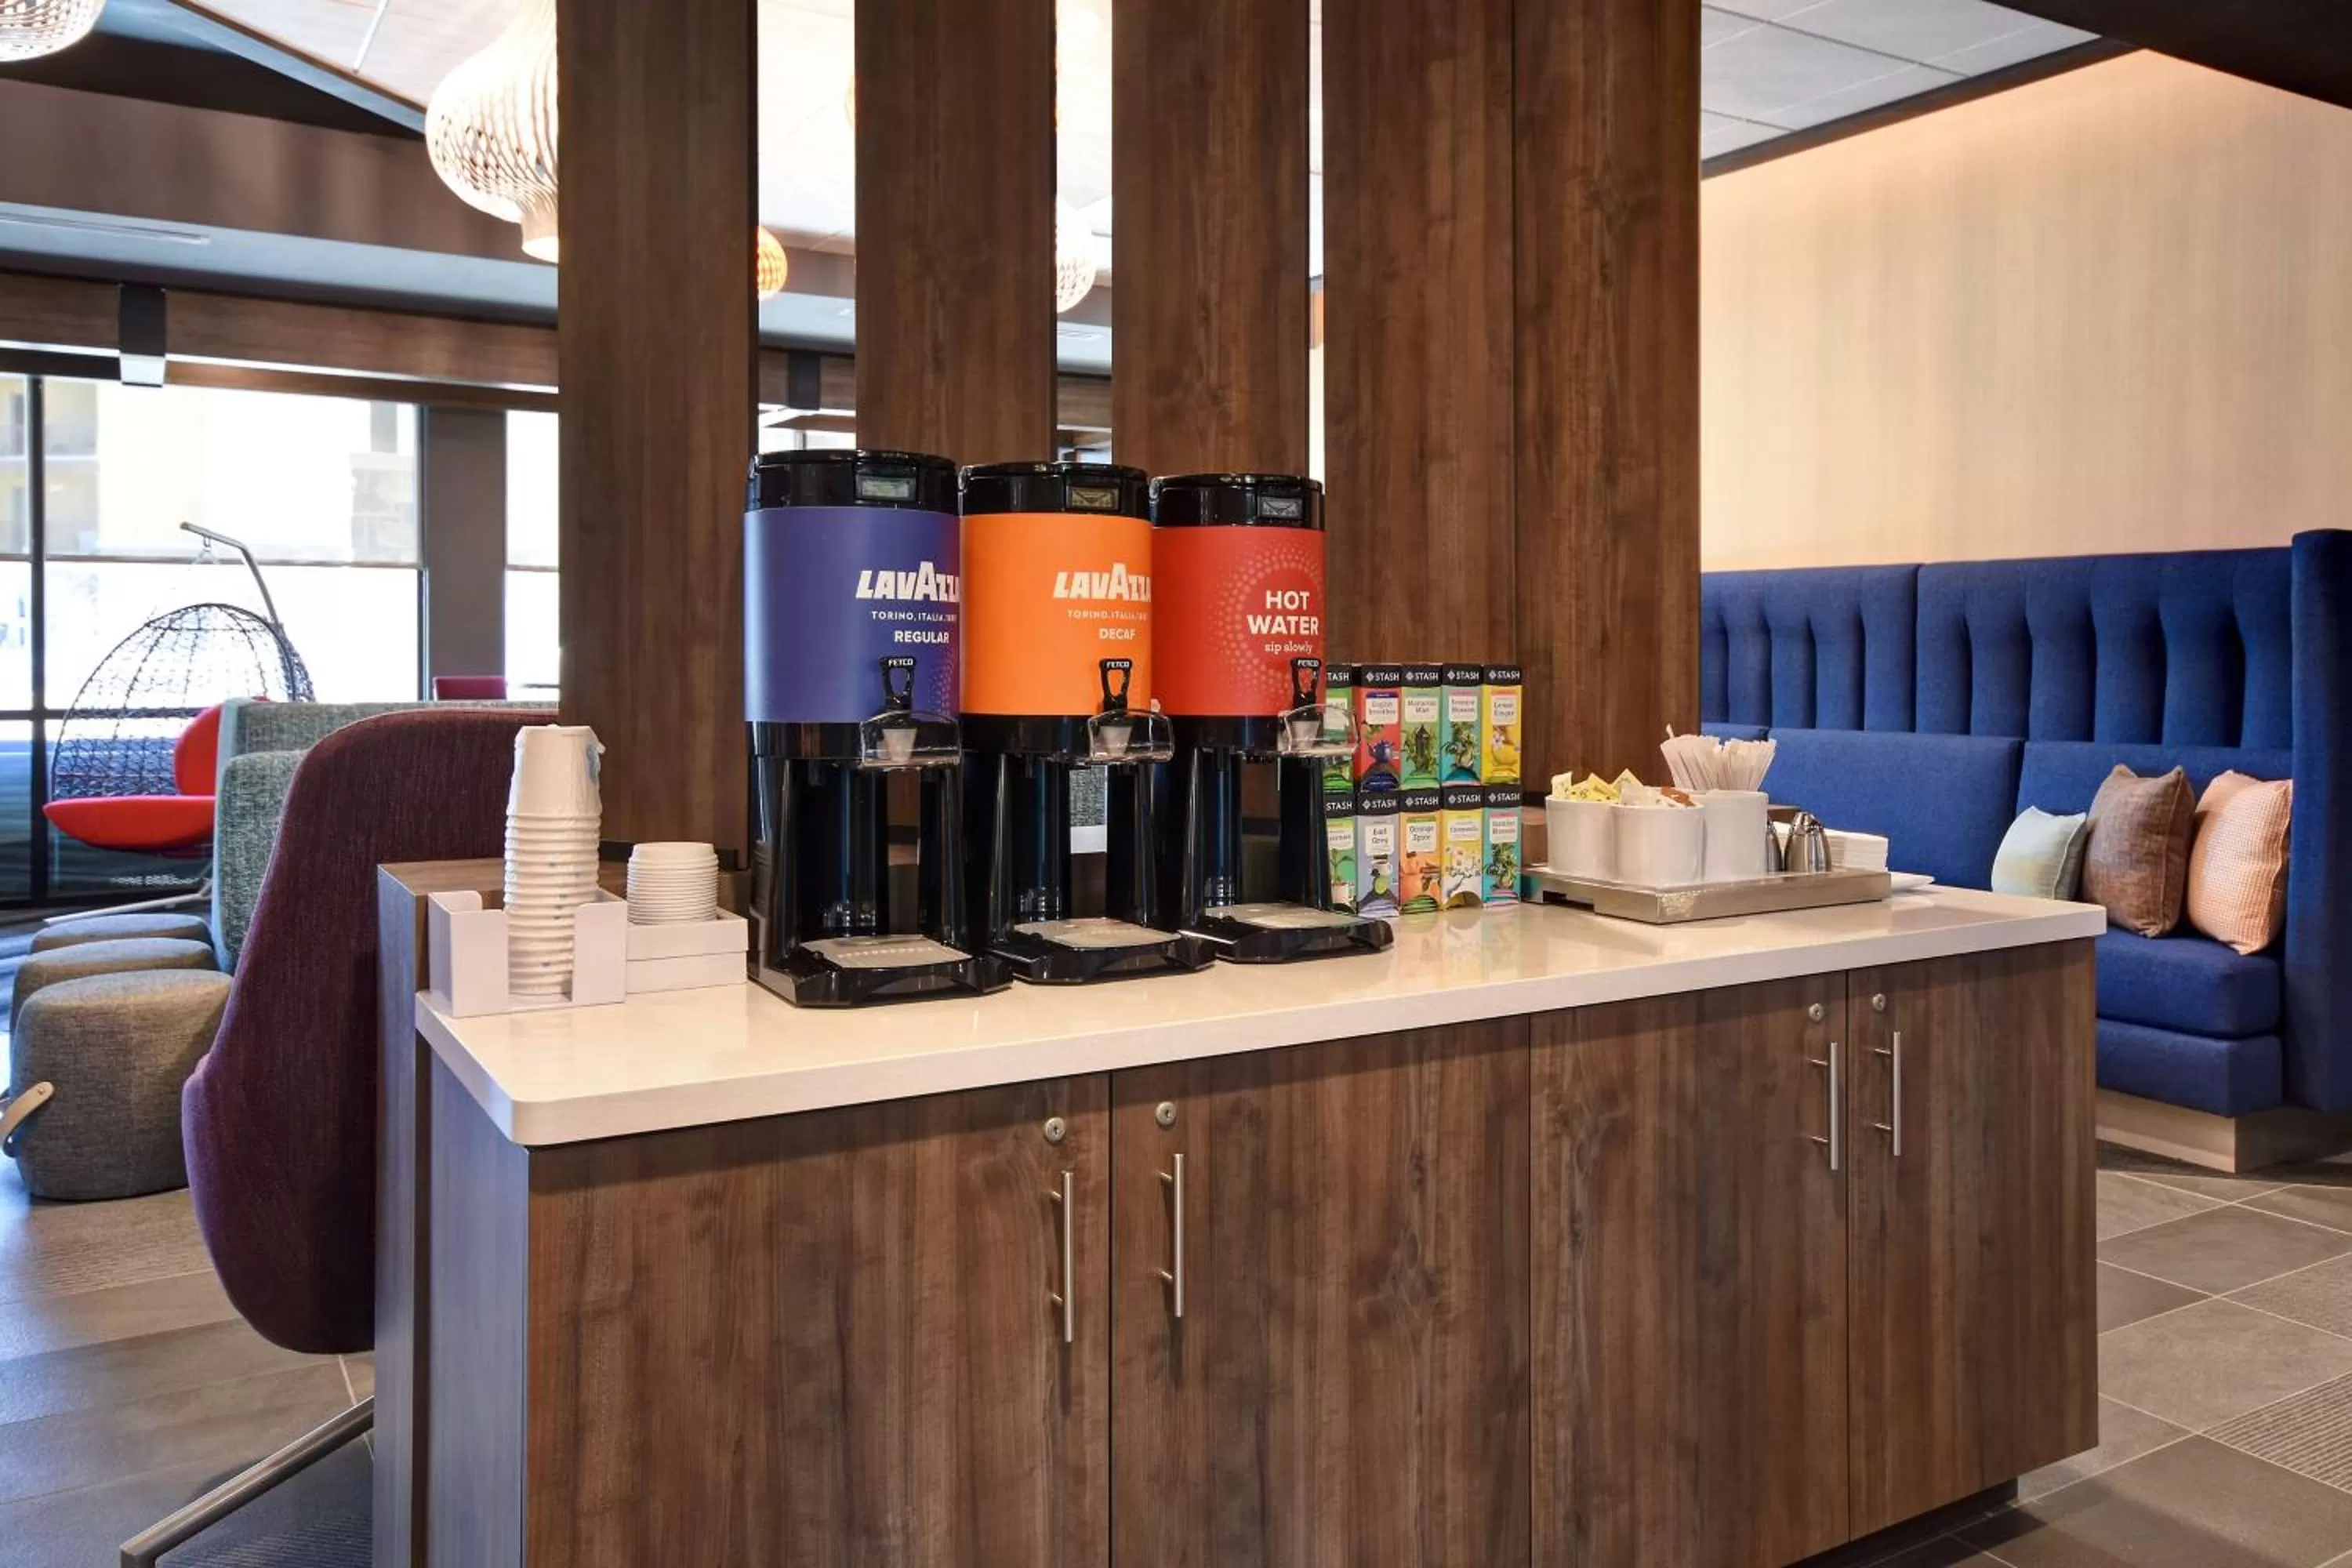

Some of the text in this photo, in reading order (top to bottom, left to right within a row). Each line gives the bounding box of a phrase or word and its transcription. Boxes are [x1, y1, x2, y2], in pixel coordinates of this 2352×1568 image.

[1265, 590, 1310, 611] HOT
[1247, 614, 1319, 636] WATER
[894, 630, 950, 644] REGULAR
[1099, 628, 1136, 641] DECAF
[1265, 641, 1313, 655] sip slowly
[1327, 672, 1349, 681] TASH
[1375, 672, 1399, 681] STASH
[1415, 672, 1439, 681] STASH
[1456, 671, 1479, 681] STASH
[1497, 670, 1520, 679] STASH
[1414, 797, 1439, 805] STASH
[1457, 794, 1481, 803] STASH
[1326, 801, 1352, 811] STASH
[1372, 800, 1396, 808] STASH
